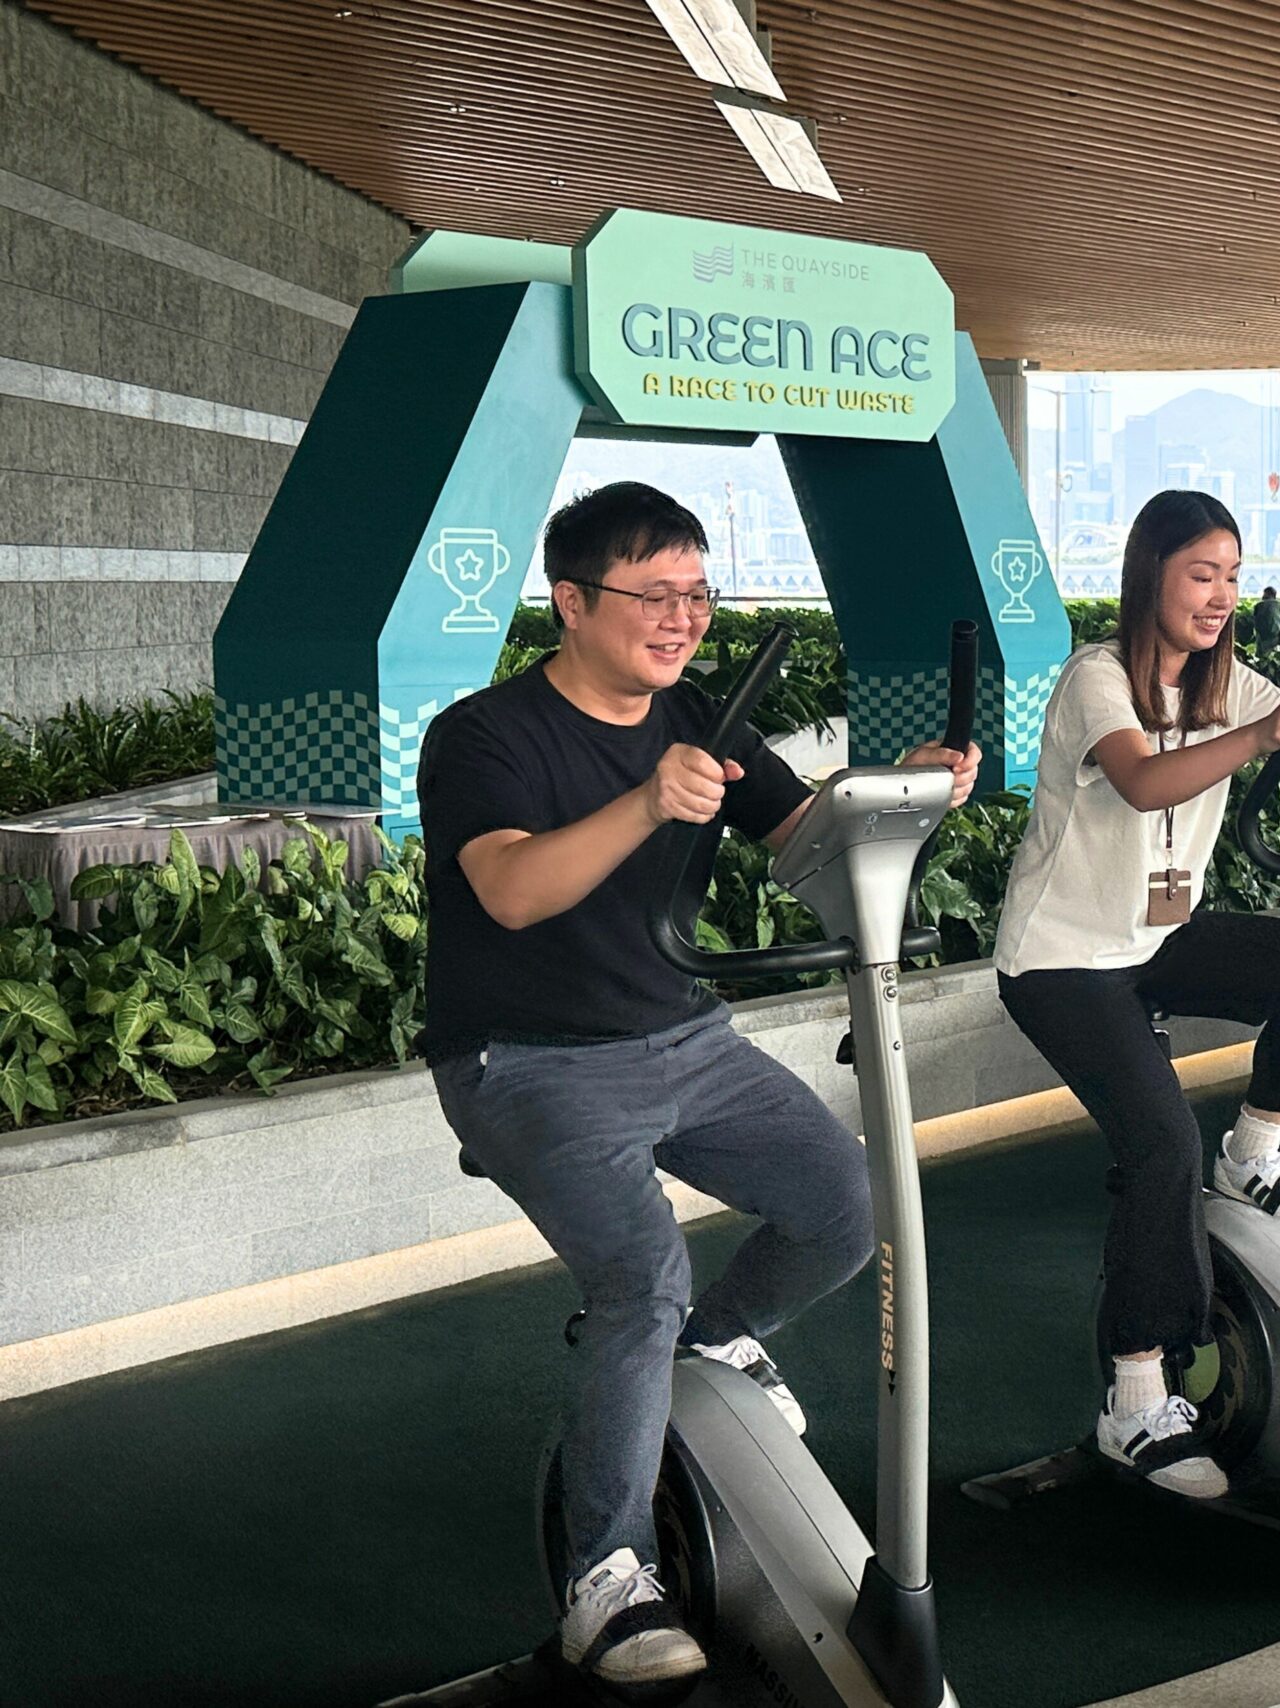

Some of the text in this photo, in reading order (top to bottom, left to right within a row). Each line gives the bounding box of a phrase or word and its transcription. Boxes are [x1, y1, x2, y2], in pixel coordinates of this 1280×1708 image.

[742, 249, 870, 282] THE QUAYSIDE
[742, 270, 796, 293] 海濱匯
[621, 303, 932, 382] GREEN ACE
[643, 372, 916, 415] A RACE TO CUT WASTE
[880, 1241, 895, 1371] FITNESS
[746, 1643, 804, 1708] MASSI
